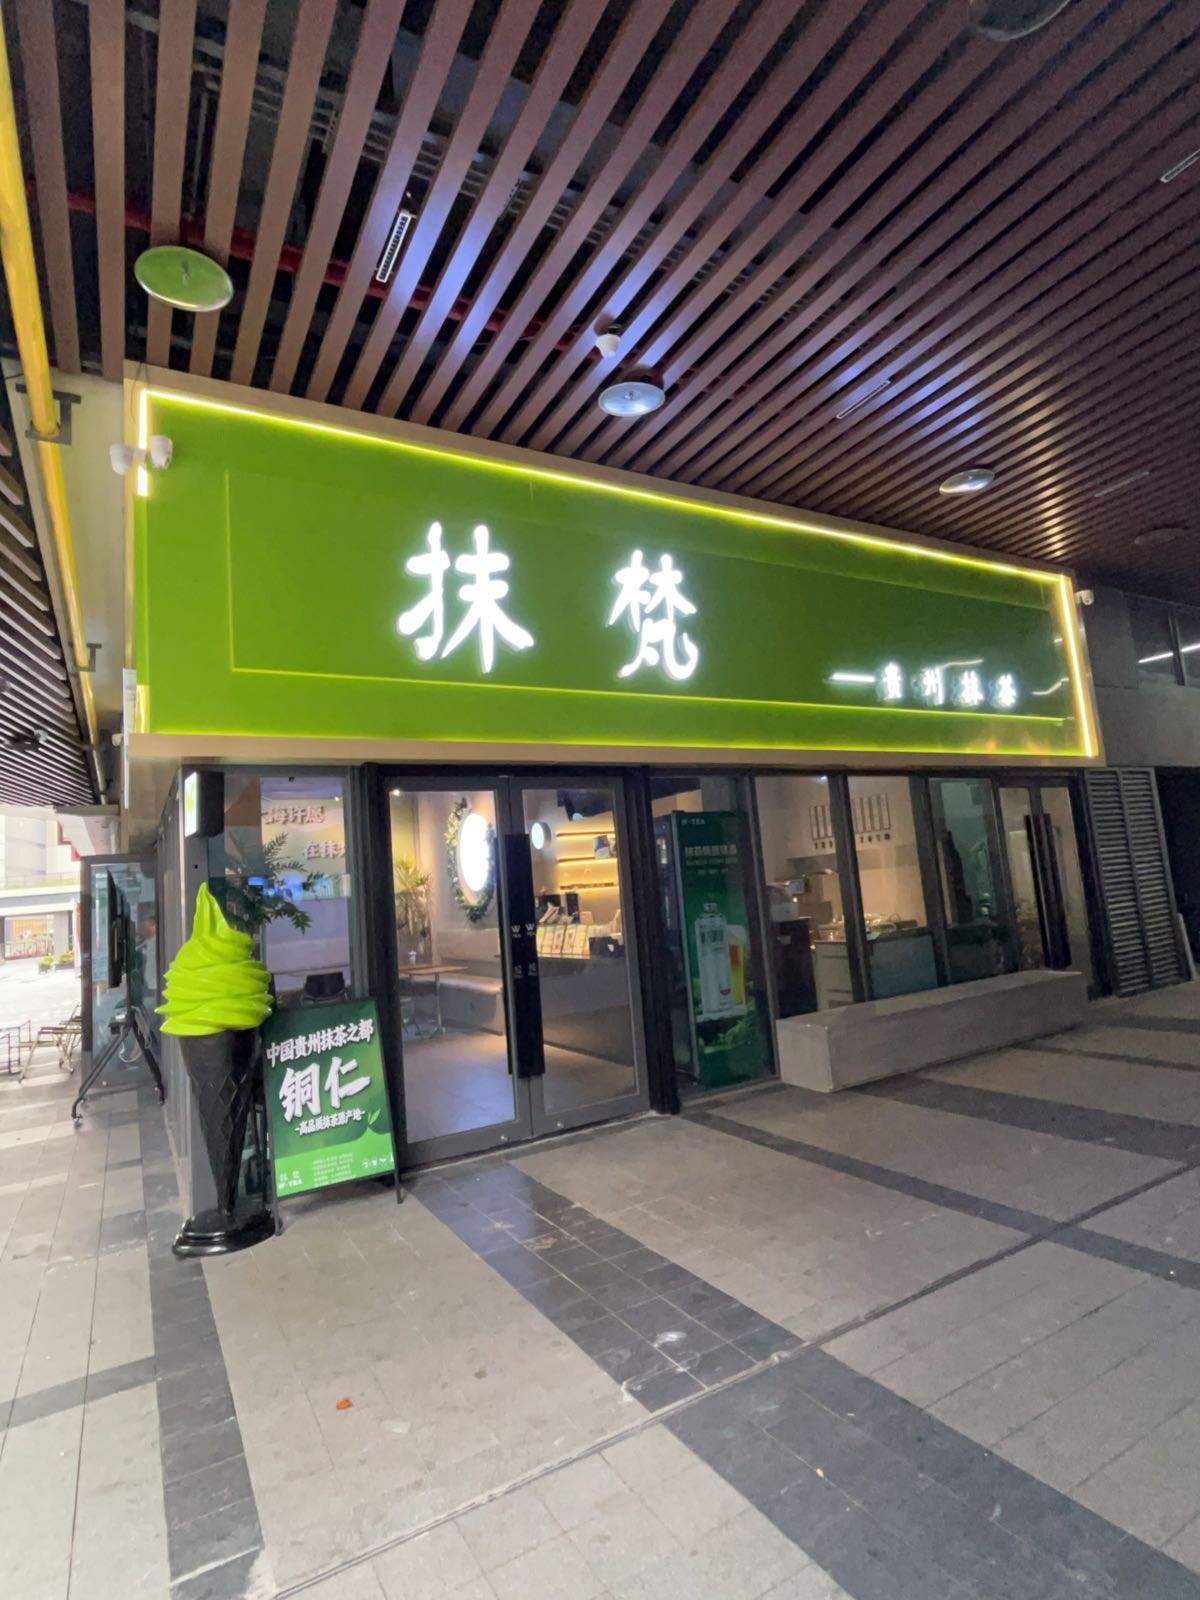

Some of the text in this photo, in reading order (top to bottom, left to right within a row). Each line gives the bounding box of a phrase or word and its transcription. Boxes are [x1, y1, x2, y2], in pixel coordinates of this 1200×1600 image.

[303, 840, 345, 859] 在抹
[266, 1018, 374, 1068] 中国贵州抹茶之都
[279, 1056, 371, 1122] 铜仁
